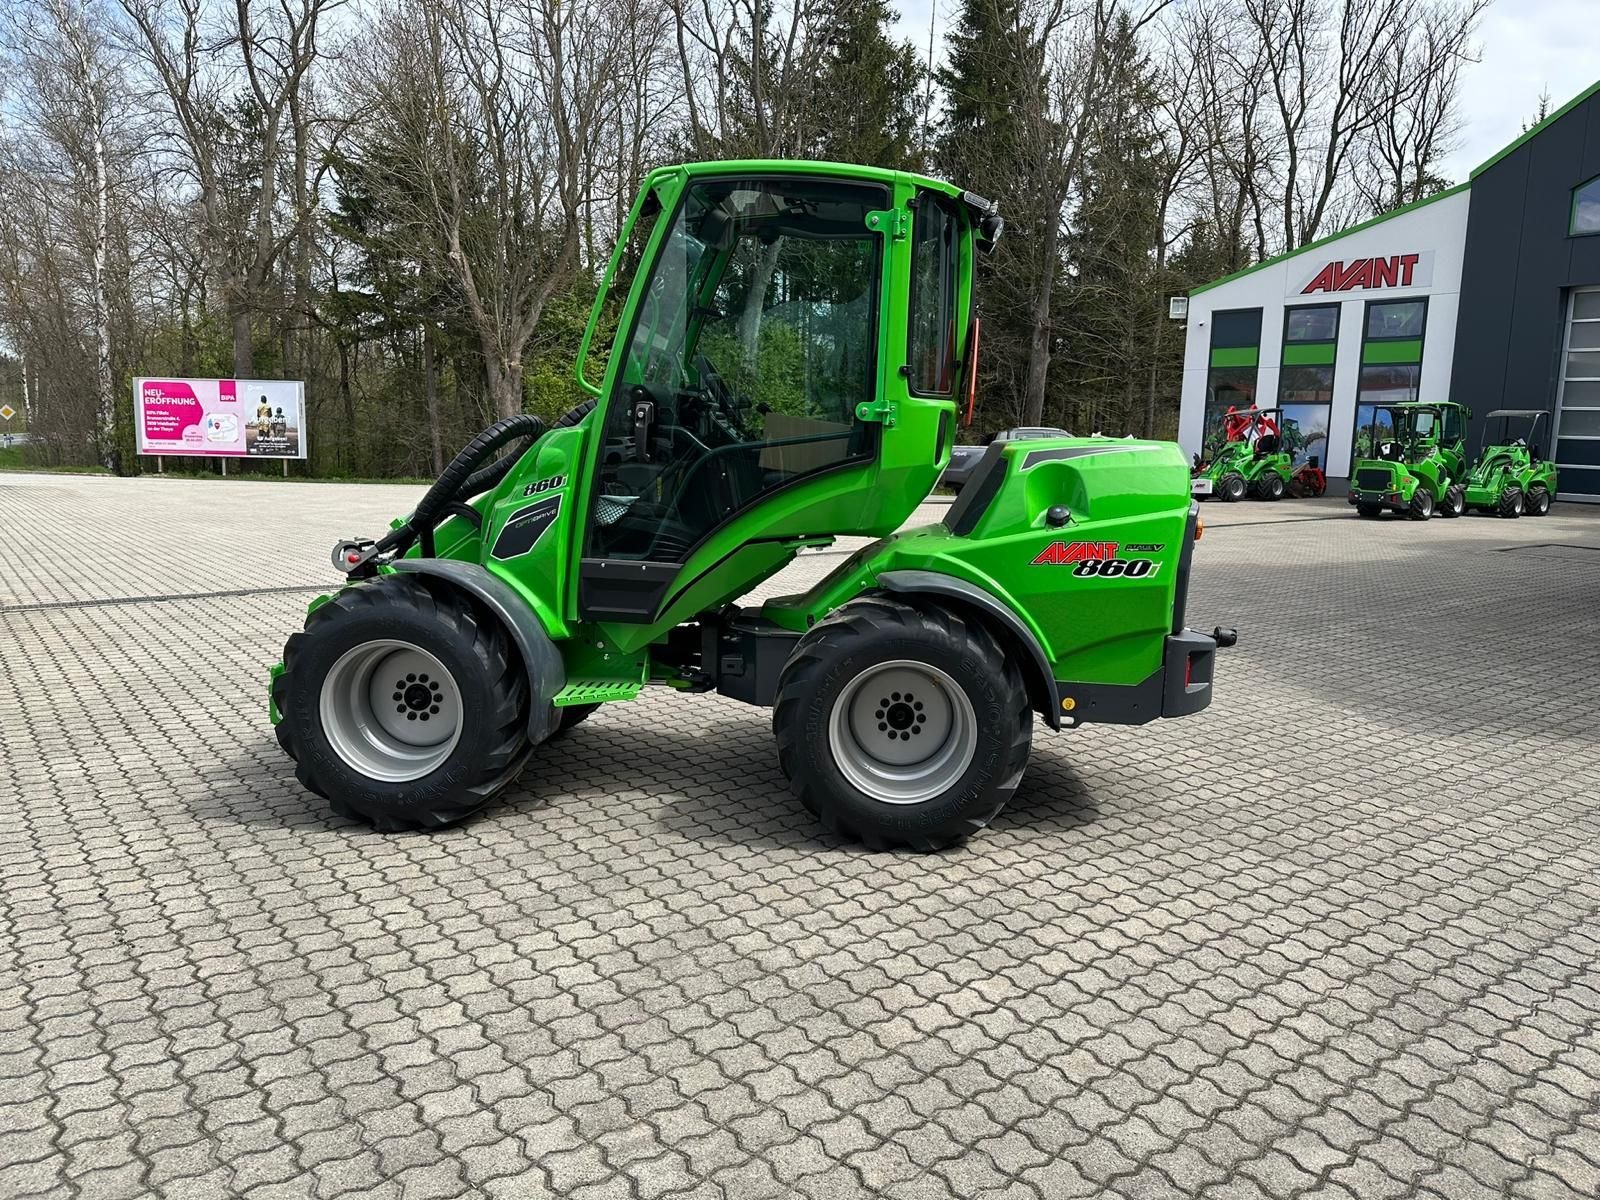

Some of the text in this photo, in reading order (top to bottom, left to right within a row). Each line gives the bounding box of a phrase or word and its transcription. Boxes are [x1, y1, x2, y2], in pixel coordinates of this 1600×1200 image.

[1300, 253, 1420, 294] AVANT
[144, 389, 165, 397] NEU-
[144, 395, 196, 406] ERÖFFNUNG
[1029, 540, 1120, 565] AVANT
